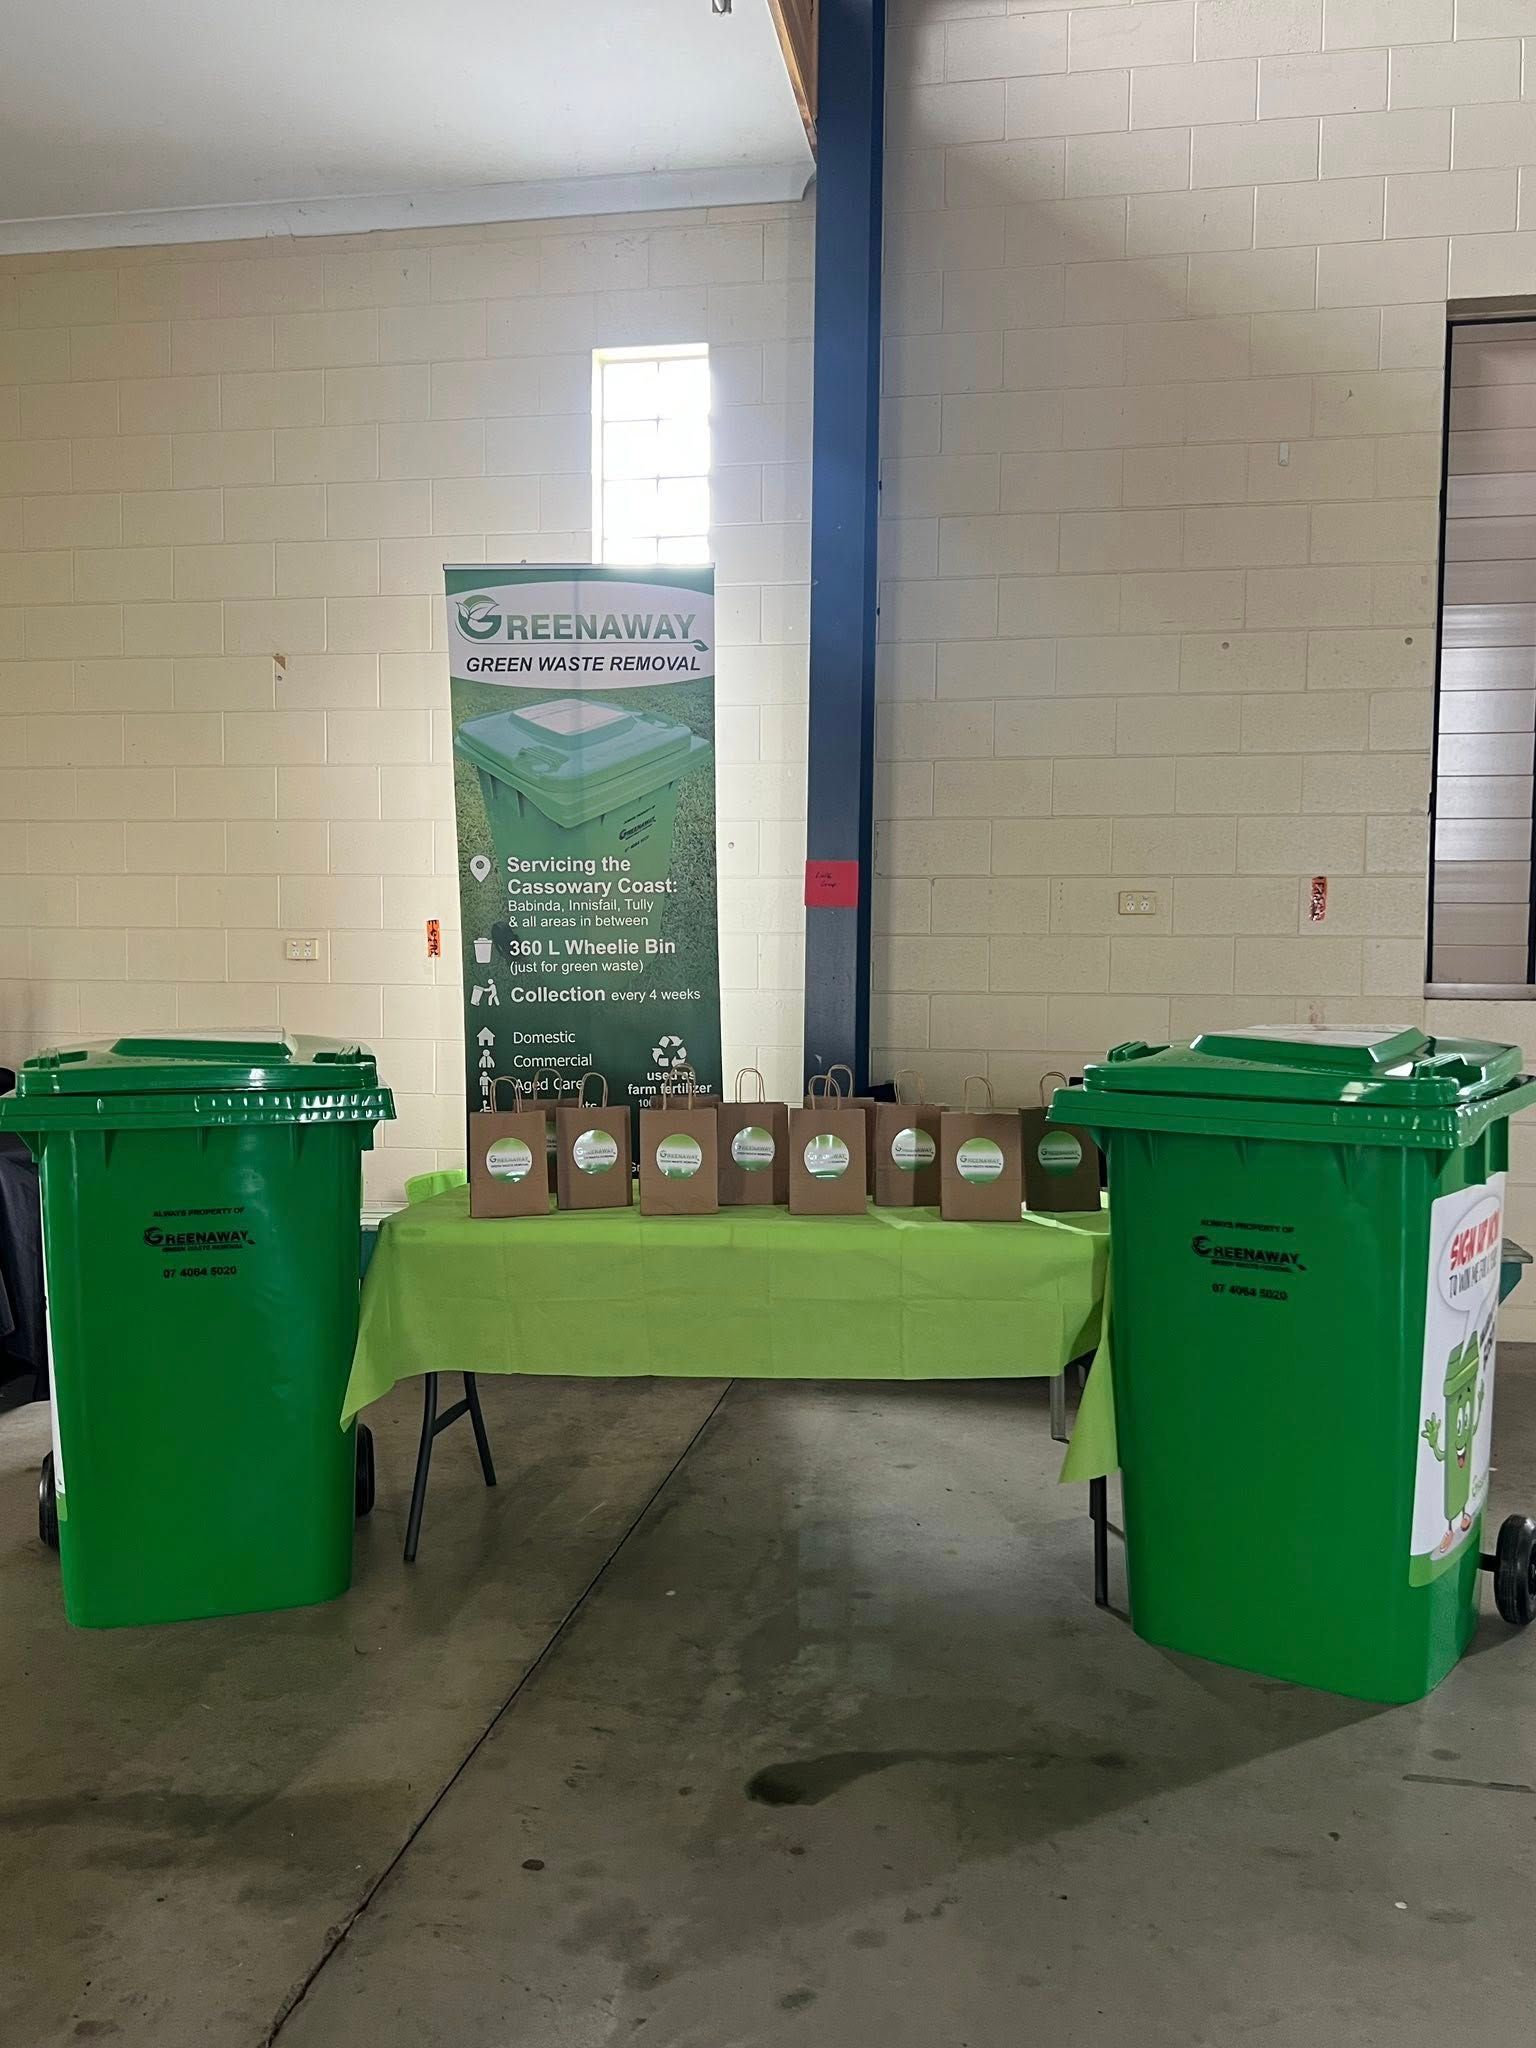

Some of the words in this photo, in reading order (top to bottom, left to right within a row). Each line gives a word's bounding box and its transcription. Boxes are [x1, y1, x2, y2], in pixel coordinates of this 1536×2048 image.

[456, 595, 697, 641] GREENAWAY
[466, 657, 532, 673] GREEN
[538, 656, 605, 672] WASTE
[609, 656, 701, 672] REMOVAL
[507, 856, 596, 876] Servicing
[601, 856, 631, 872] the
[507, 878, 612, 897] Cassowary
[617, 877, 678, 894] Coast:
[508, 899, 565, 913] Babinda,
[569, 899, 621, 912] Innisfail,
[624, 898, 654, 913] Tully
[508, 916, 518, 928] &
[522, 915, 537, 928] all
[540, 917, 577, 927] areas
[580, 915, 591, 927] in
[595, 915, 649, 927] between
[509, 940, 542, 956] 360
[549, 940, 560, 956] L
[565, 939, 639, 955] Wheelie
[645, 938, 676, 954] Bin
[510, 961, 537, 976] (just
[541, 960, 558, 972] for
[561, 962, 598, 975] green
[601, 960, 644, 974] waste)
[511, 986, 606, 1003] Collection
[611, 991, 646, 1003] every
[649, 990, 657, 1000] 4
[661, 989, 701, 1000] weeks
[513, 1031, 576, 1044] Domestic
[513, 1053, 593, 1068] Commercial
[647, 1069, 678, 1081] used
[681, 1072, 695, 1081] as
[553, 1077, 583, 1090] Care
[627, 1083, 657, 1095] farm
[153, 1209, 186, 1217] ALWAYS
[188, 1207, 232, 1216] PROPERTY
[233, 1206, 245, 1214] OF
[144, 1226, 249, 1247] GREENAWAY
[1192, 1235, 1300, 1264] GREENAWAY
[1450, 1225, 1477, 1271] SIGN
[163, 1268, 176, 1279] 07
[180, 1267, 207, 1277] 4064
[210, 1265, 237, 1276] 5020
[1449, 1274, 1458, 1298] TO
